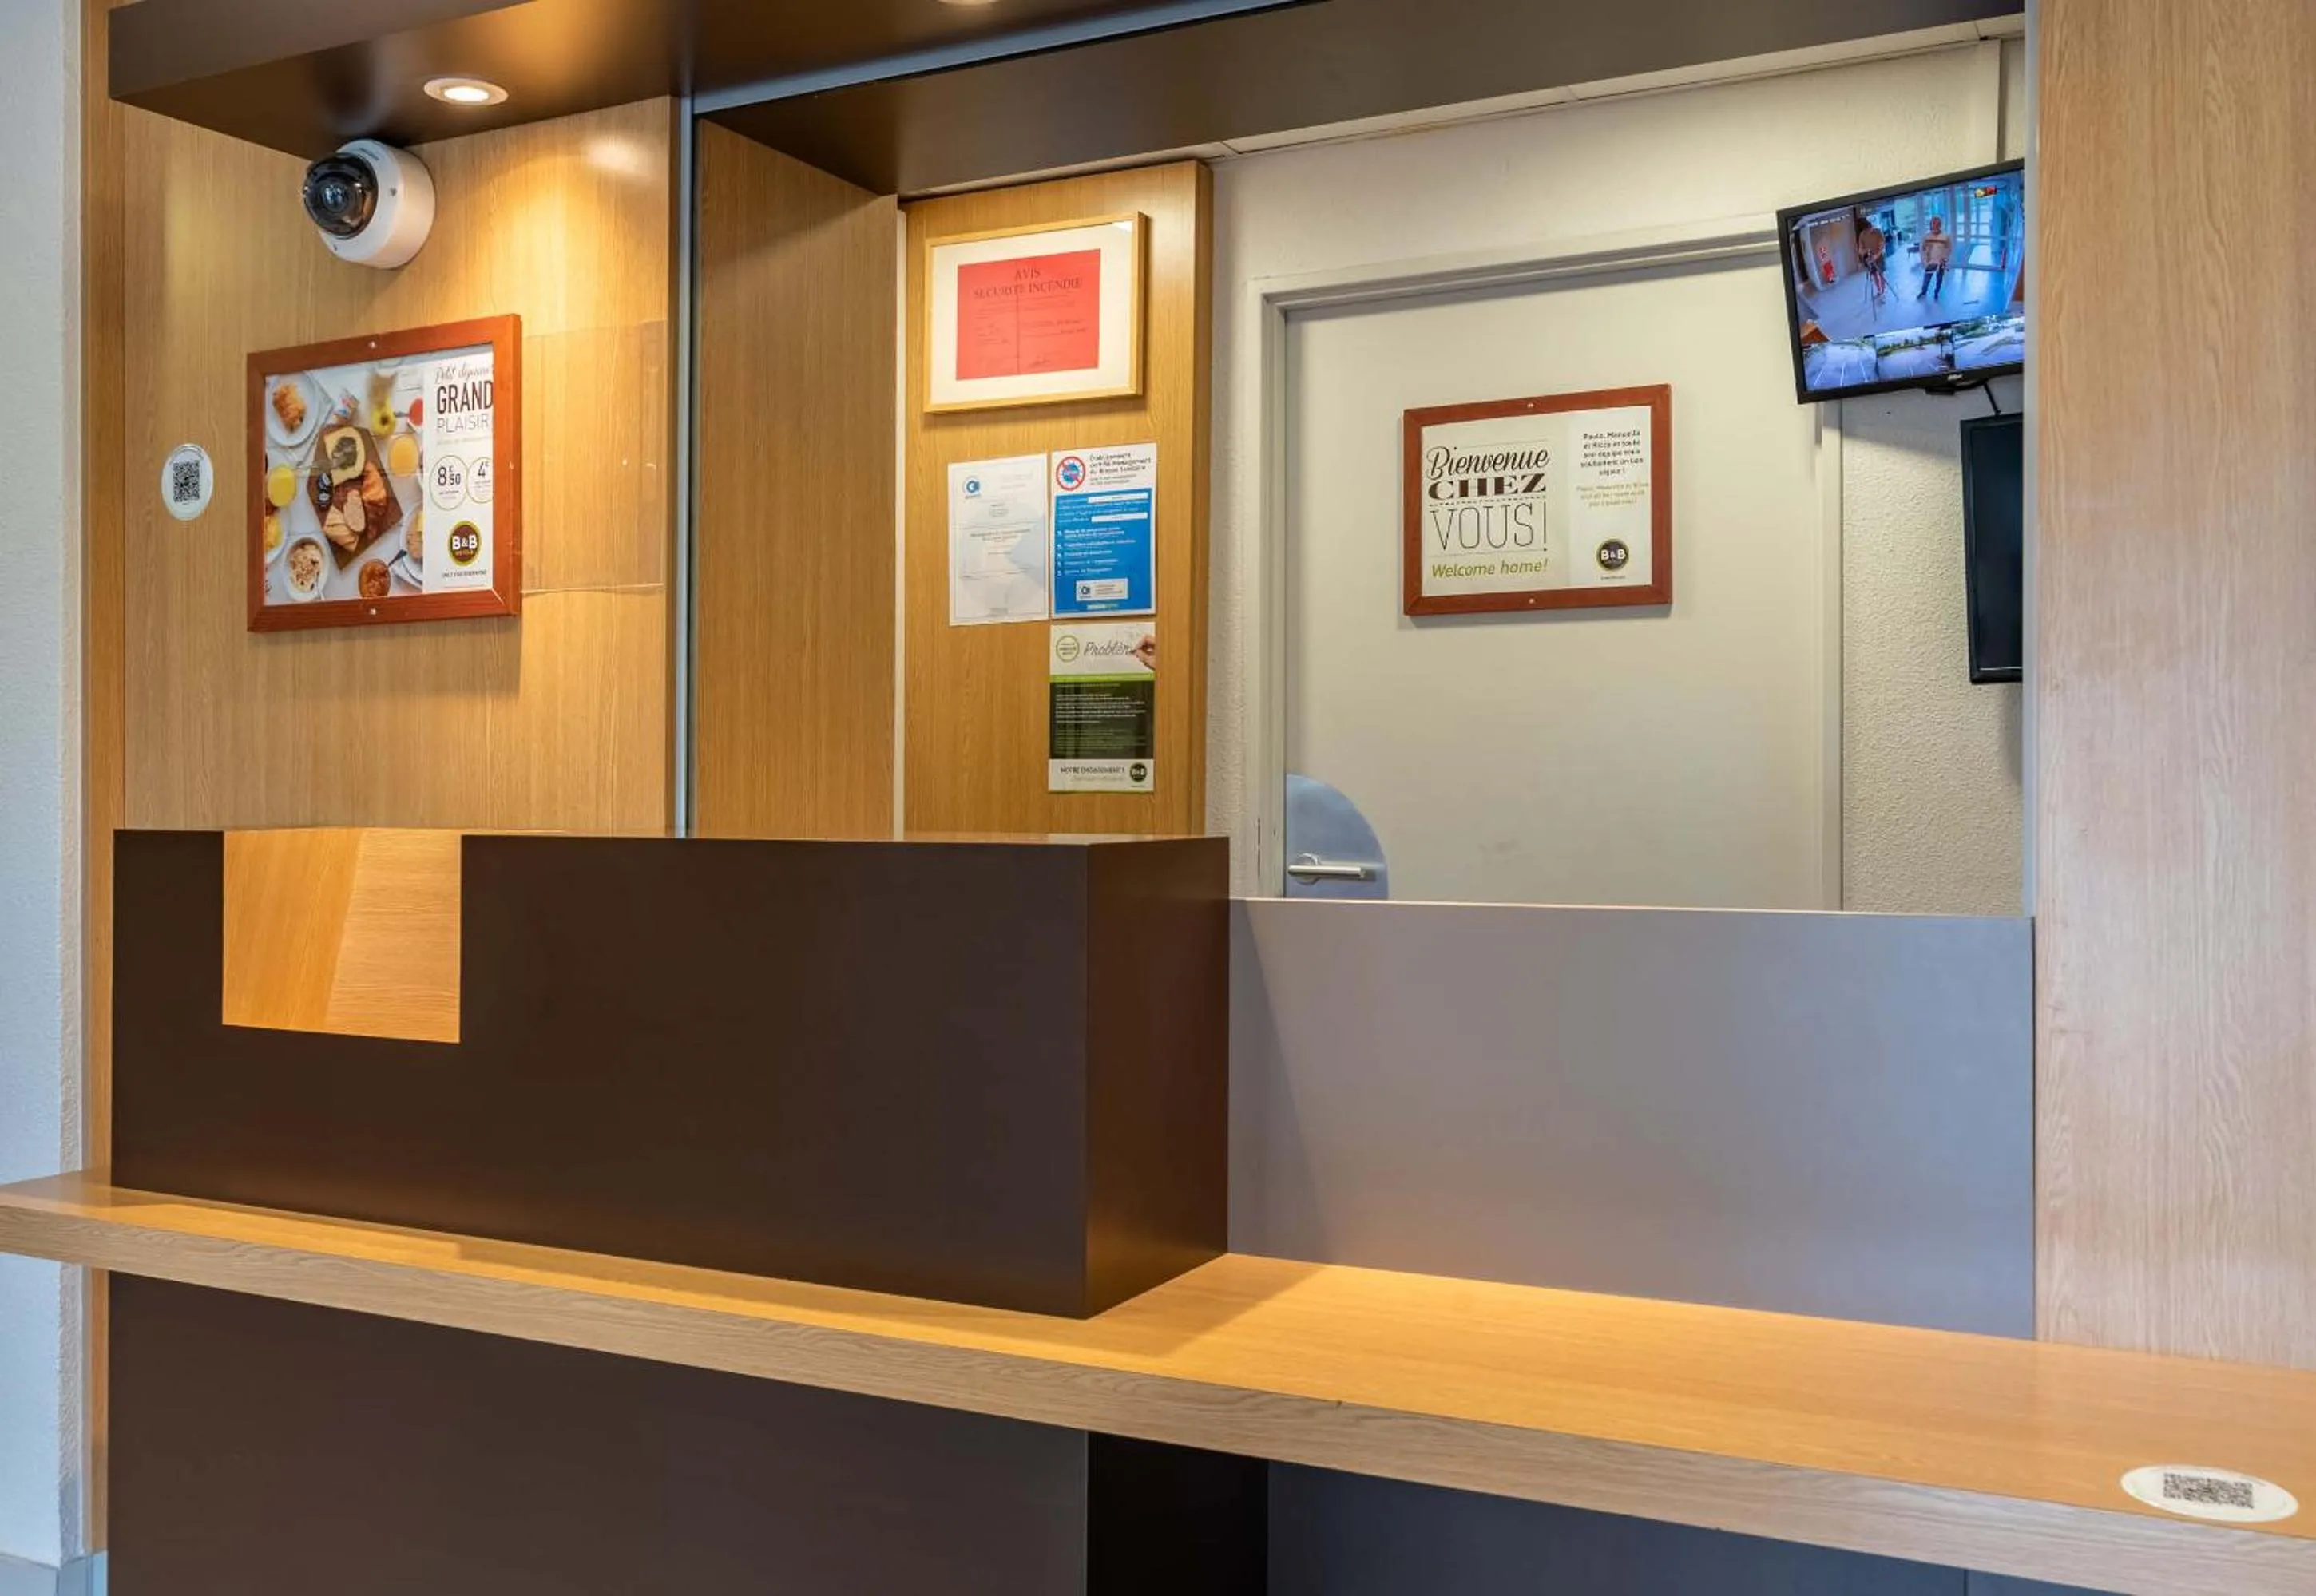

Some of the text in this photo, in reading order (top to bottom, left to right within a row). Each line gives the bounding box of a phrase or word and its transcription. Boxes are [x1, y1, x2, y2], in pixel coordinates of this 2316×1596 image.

[1015, 267, 1041, 281] AVIS
[437, 379, 494, 414] GRAND
[437, 413, 489, 433] PLAISIR
[1426, 446, 1550, 480] Bienvenue
[1428, 473, 1547, 500] CHEZ
[452, 533, 478, 550] B&B
[1601, 549, 1625, 560] B&B
[1432, 558, 1548, 578] Welcome home!
